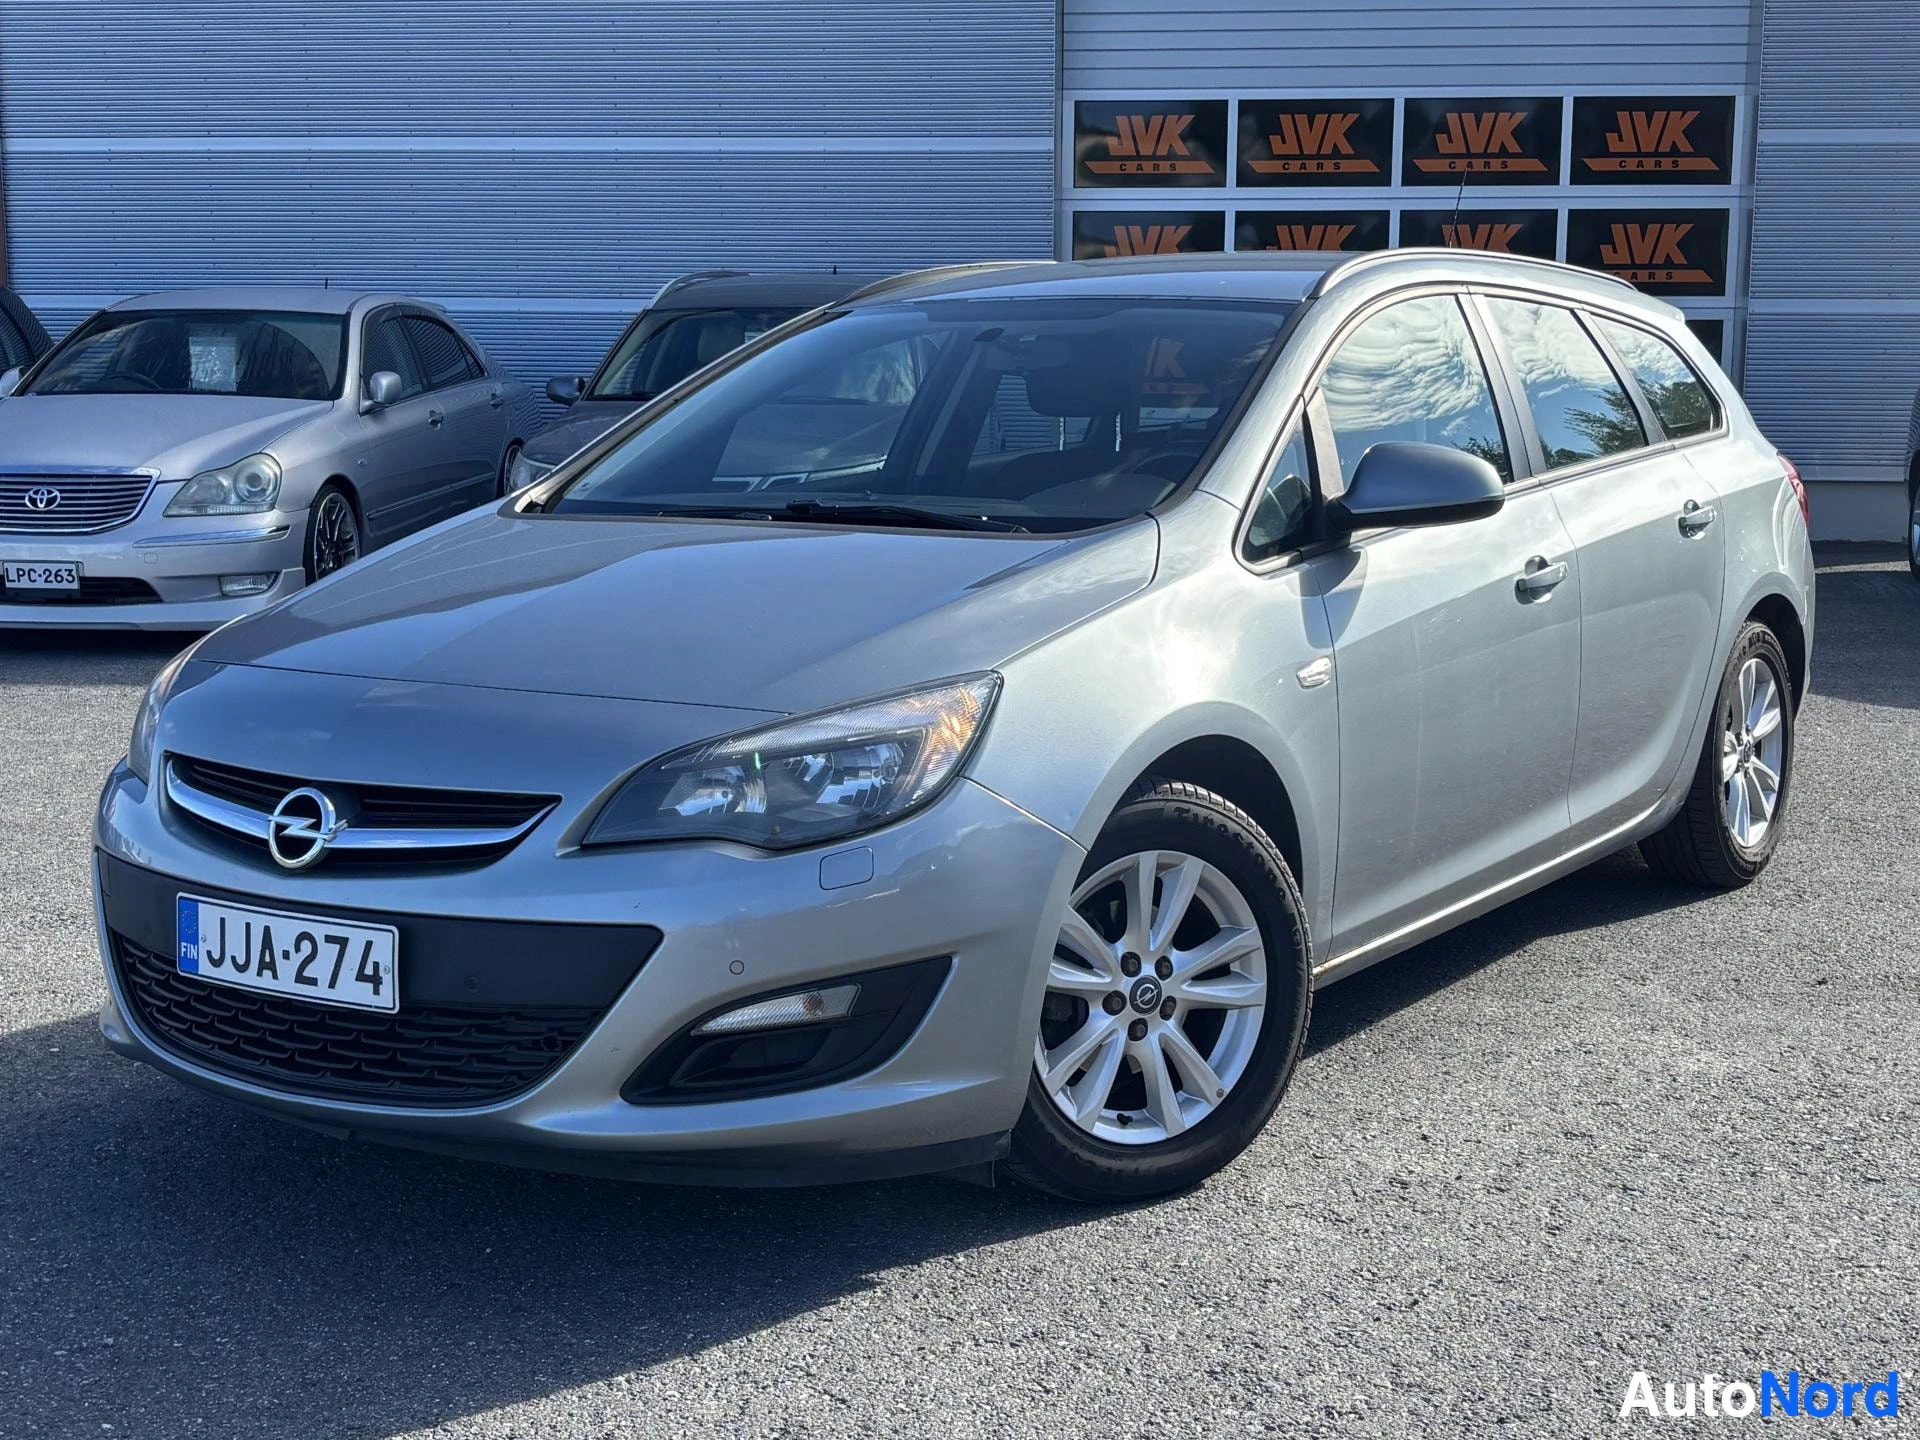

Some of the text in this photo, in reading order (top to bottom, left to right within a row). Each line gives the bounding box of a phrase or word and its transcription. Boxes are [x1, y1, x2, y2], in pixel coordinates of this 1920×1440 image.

[1106, 115, 1196, 156] JVK
[1269, 113, 1360, 155] JVK
[1435, 112, 1528, 154] JVK
[1605, 110, 1700, 153] JVK
[1119, 162, 1177, 172] CARS
[1282, 161, 1341, 171] CARS
[1448, 160, 1508, 170] CARS
[1619, 159, 1680, 169] CARS
[1103, 225, 1192, 257] JVK
[1600, 223, 1694, 265] JVK
[5, 567, 76, 584] LPC-263
[181, 942, 198, 960] FIN
[206, 916, 383, 996] JJA-274
